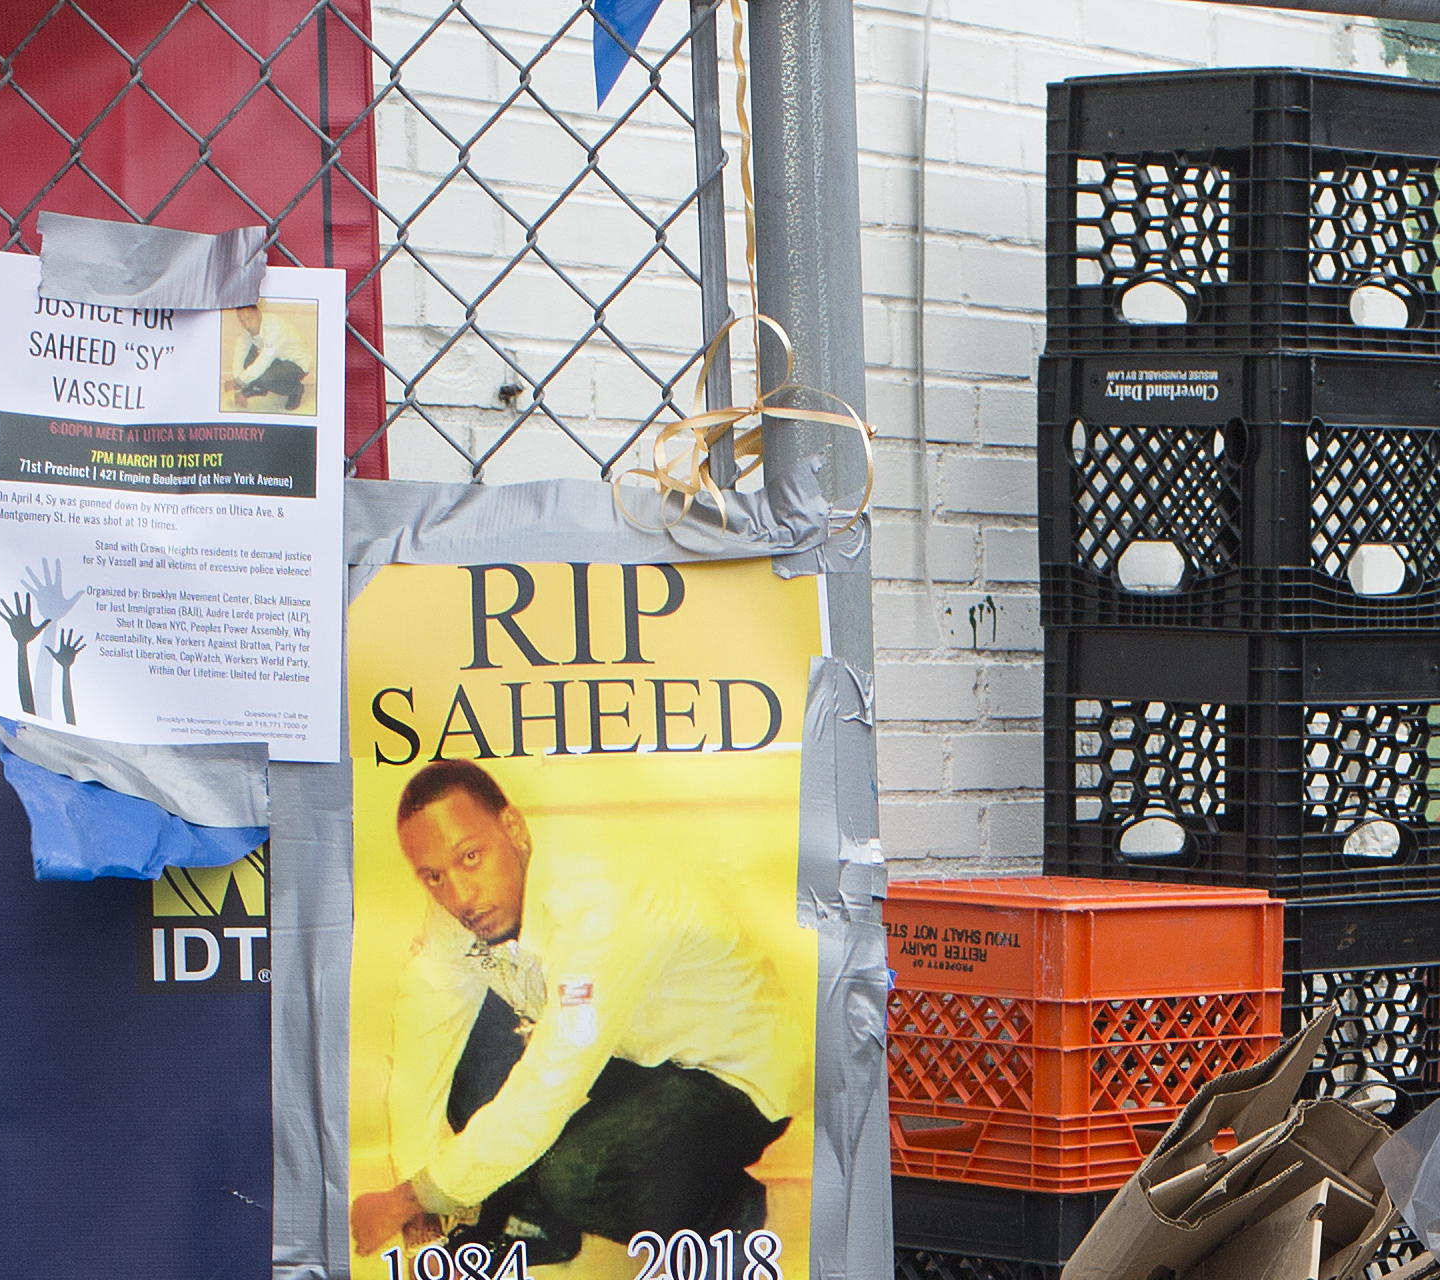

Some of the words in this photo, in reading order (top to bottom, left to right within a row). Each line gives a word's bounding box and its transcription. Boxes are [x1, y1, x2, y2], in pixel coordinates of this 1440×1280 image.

[34, 297, 124, 324] JUSTICE
[133, 308, 174, 331] FOR
[29, 331, 116, 366] SAHEED
[53, 376, 146, 410] VASSELL
[1105, 380, 1142, 401] Dairy
[1146, 383, 1219, 401] Cloverland
[91, 449, 113, 464] 7PM
[116, 452, 157, 468] MARCH
[160, 454, 174, 468] TO
[177, 453, 200, 467] 71ST
[203, 453, 223, 467] PCT
[19, 457, 42, 473] 71st
[44, 460, 90, 478] Precinct
[99, 468, 116, 480] 421
[119, 469, 150, 484] Empire
[152, 473, 196, 485] Boulevard
[198, 473, 211, 486] (at
[213, 472, 232, 484] New
[233, 471, 255, 485] York
[256, 473, 292, 489] Avenue)
[459, 563, 689, 671] RIP
[372, 679, 782, 767] SAHEED
[882, 920, 908, 938] STE
[913, 924, 938, 941] NOT
[942, 927, 981, 945] SHALT
[900, 940, 937, 958] DAIRY
[985, 931, 1020, 948] THOU
[152, 928, 266, 982] IDT
[944, 945, 987, 962] REITER
[927, 960, 973, 972] PROPERTY
